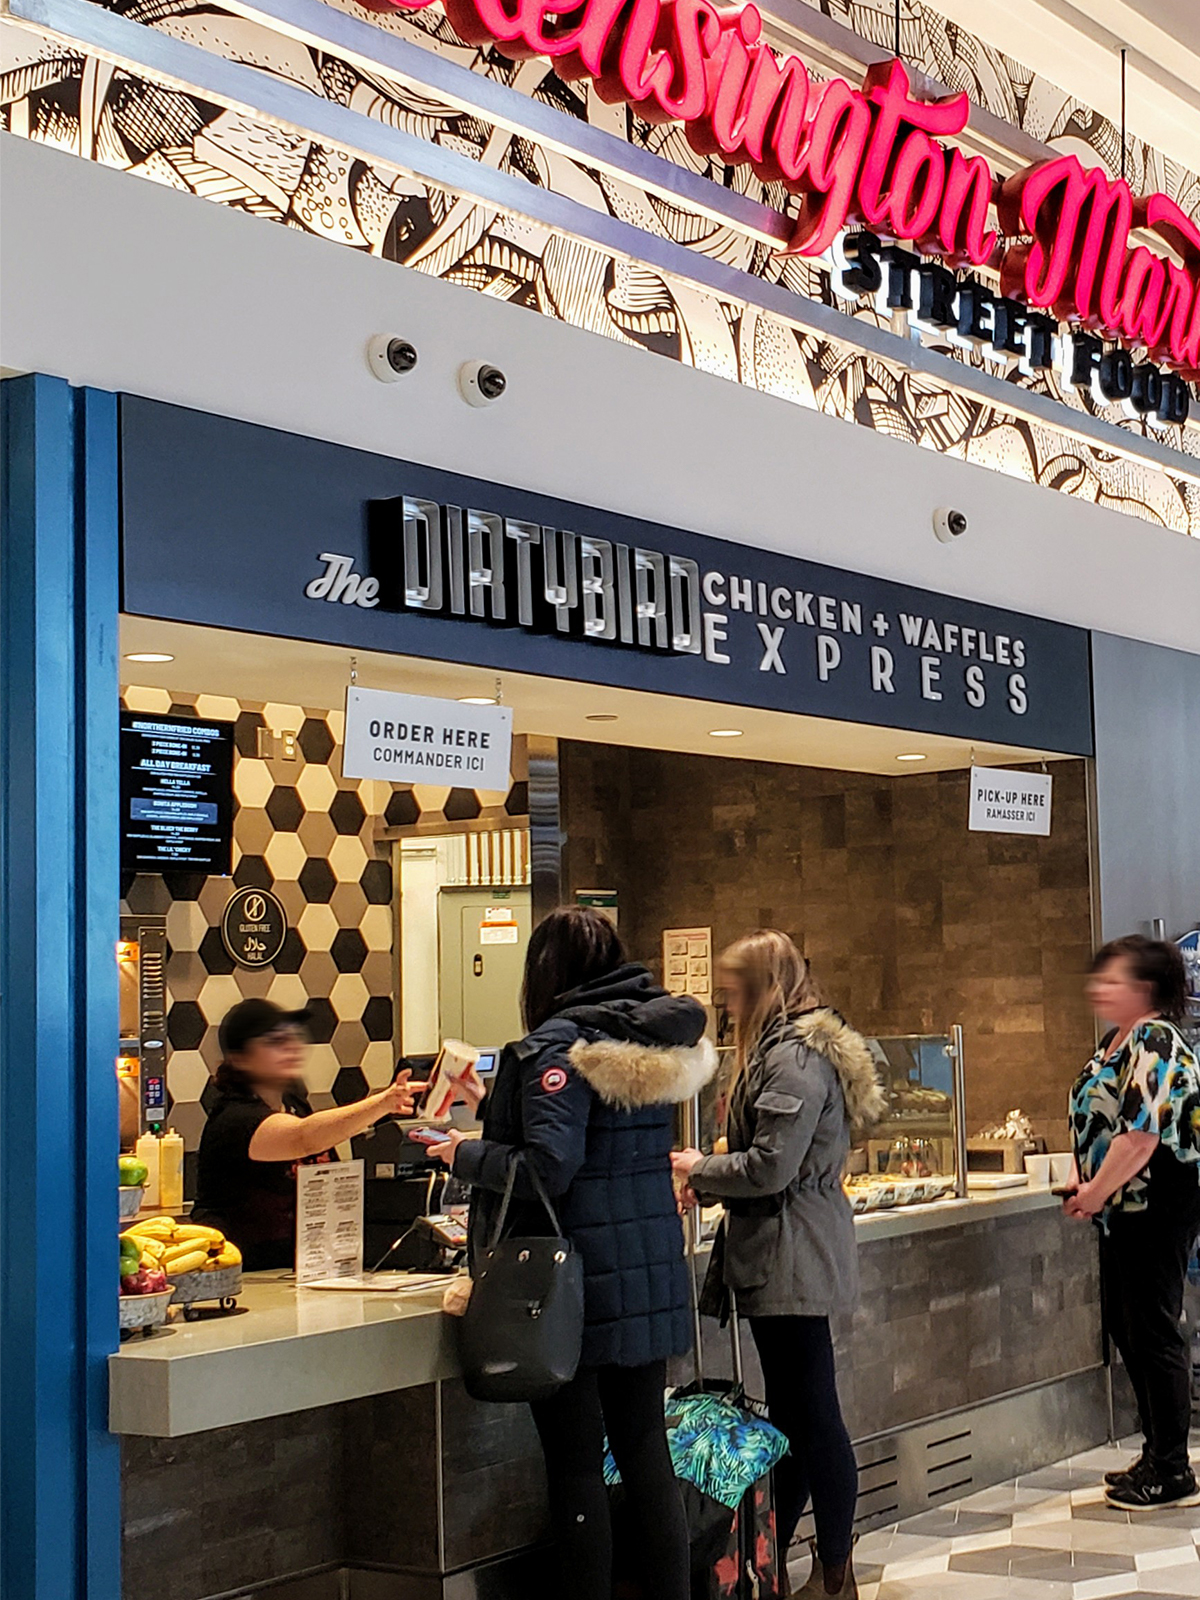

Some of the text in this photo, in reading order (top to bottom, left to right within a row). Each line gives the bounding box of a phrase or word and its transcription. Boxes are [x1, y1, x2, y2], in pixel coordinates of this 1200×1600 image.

[386, 0, 997, 258] nsington
[838, 230, 1190, 425] STREET FOOD
[304, 495, 702, 655] The DIRTYBIRD
[702, 571, 862, 636] CHICKEN
[899, 613, 1026, 668] WAFFLES
[703, 612, 1029, 715] EXPRESS
[369, 720, 490, 749] ORDER HERE
[373, 747, 485, 771] COMMANDER ICI
[977, 788, 1045, 807] PICK-UP HERE
[986, 808, 1036, 822] RAMASSER ICI
[239, 923, 271, 933] GLUTEN FREE
